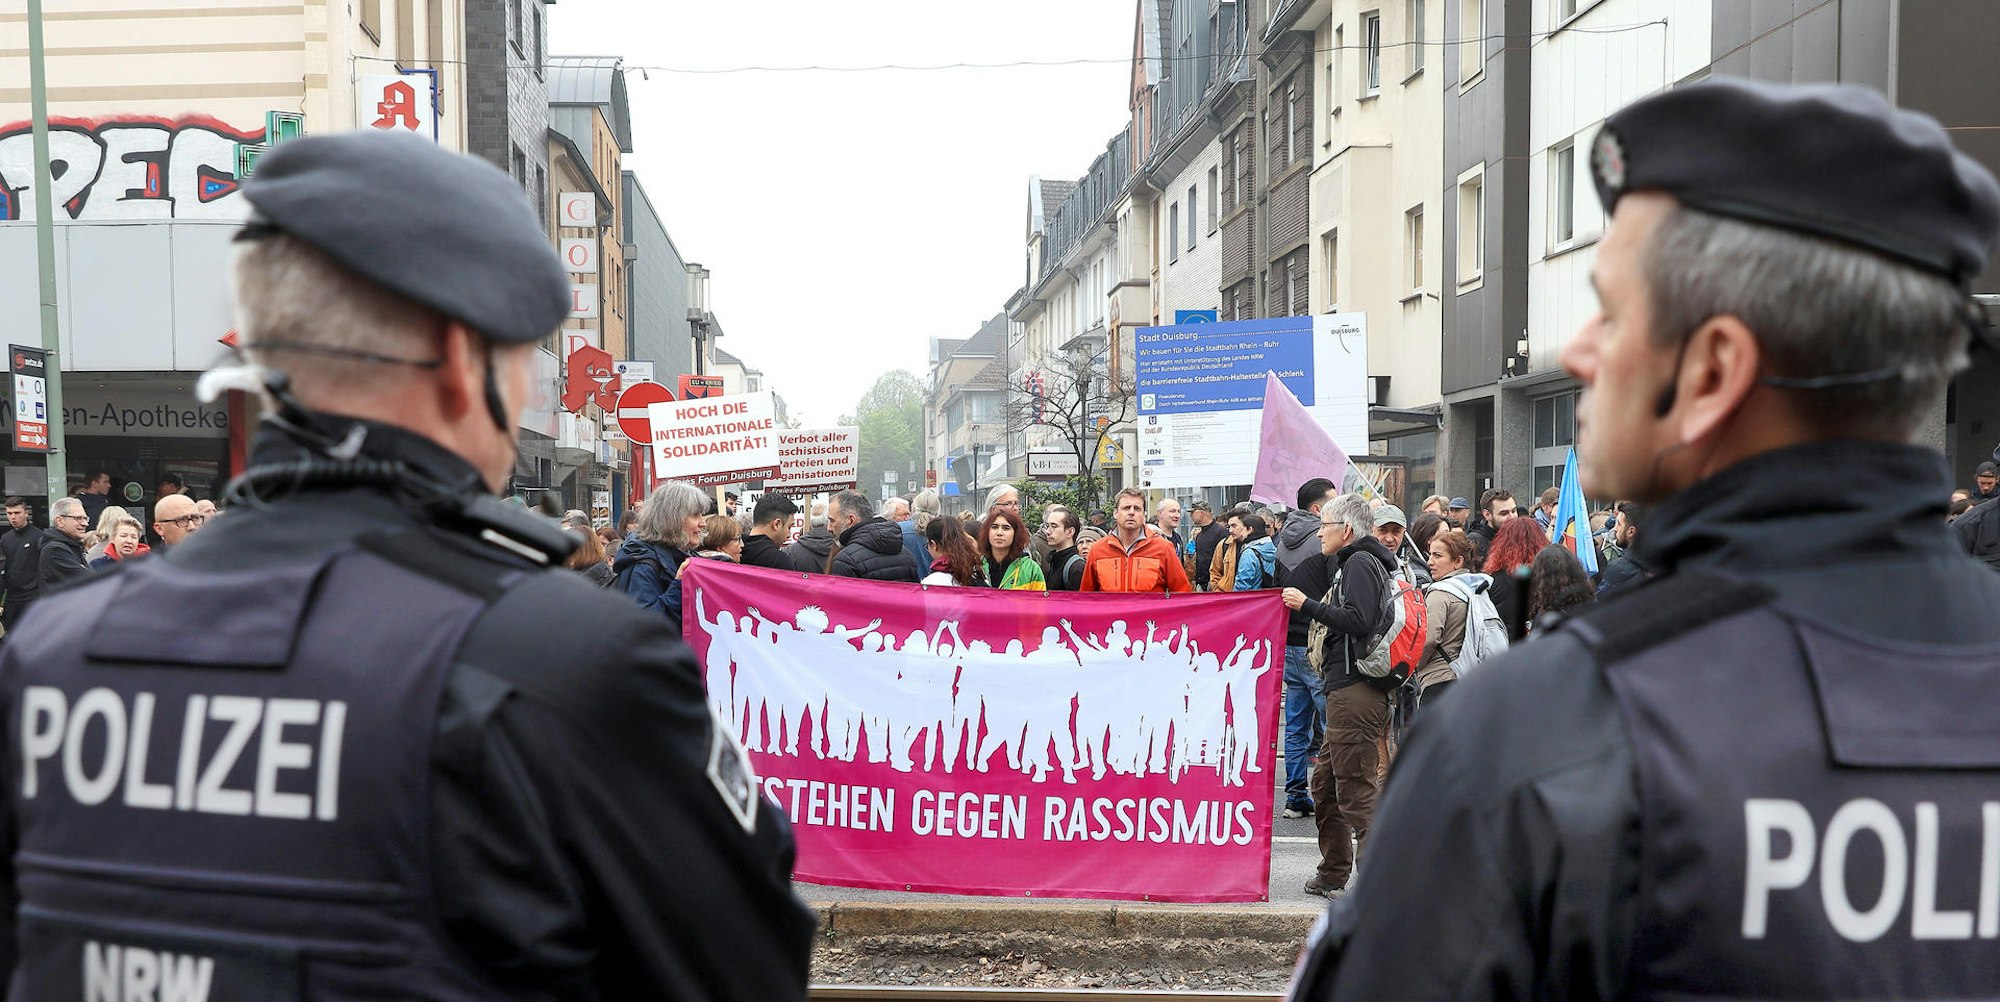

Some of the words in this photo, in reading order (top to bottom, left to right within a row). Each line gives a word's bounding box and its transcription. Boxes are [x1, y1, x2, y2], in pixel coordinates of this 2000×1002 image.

[1139, 333, 1160, 342] Stadt
[1162, 331, 1198, 342] Duisburg
[1206, 343, 1238, 351] Stadtbahn
[1239, 342, 1258, 350] Rhein
[1152, 376, 1193, 386] barrierefreie
[1194, 372, 1266, 383] Stadtbahn-Haltestelle
[1278, 369, 1305, 378] Schlenk
[63, 402, 229, 432] en-Apotheke
[675, 405, 718, 420] HOCH
[723, 401, 748, 415] DIE
[655, 418, 773, 441] INTERNATIONALE
[780, 434, 819, 444] Verbot
[822, 432, 848, 442] aller
[663, 436, 768, 459] SOLIDARITÄT!
[778, 445, 853, 457] aschistischen
[827, 456, 849, 466] und
[698, 474, 728, 485] Forum
[730, 469, 773, 482] Duisburg
[777, 468, 855, 482] ganisationen!
[819, 483, 850, 492] Duisburg
[21, 686, 347, 821] POLIZEI
[755, 775, 895, 833] STEHEN
[910, 789, 1026, 840] GEGEN
[1043, 796, 1255, 846] RASSISMUS
[1741, 798, 2000, 943] POLI
[83, 941, 214, 1002] NRW
